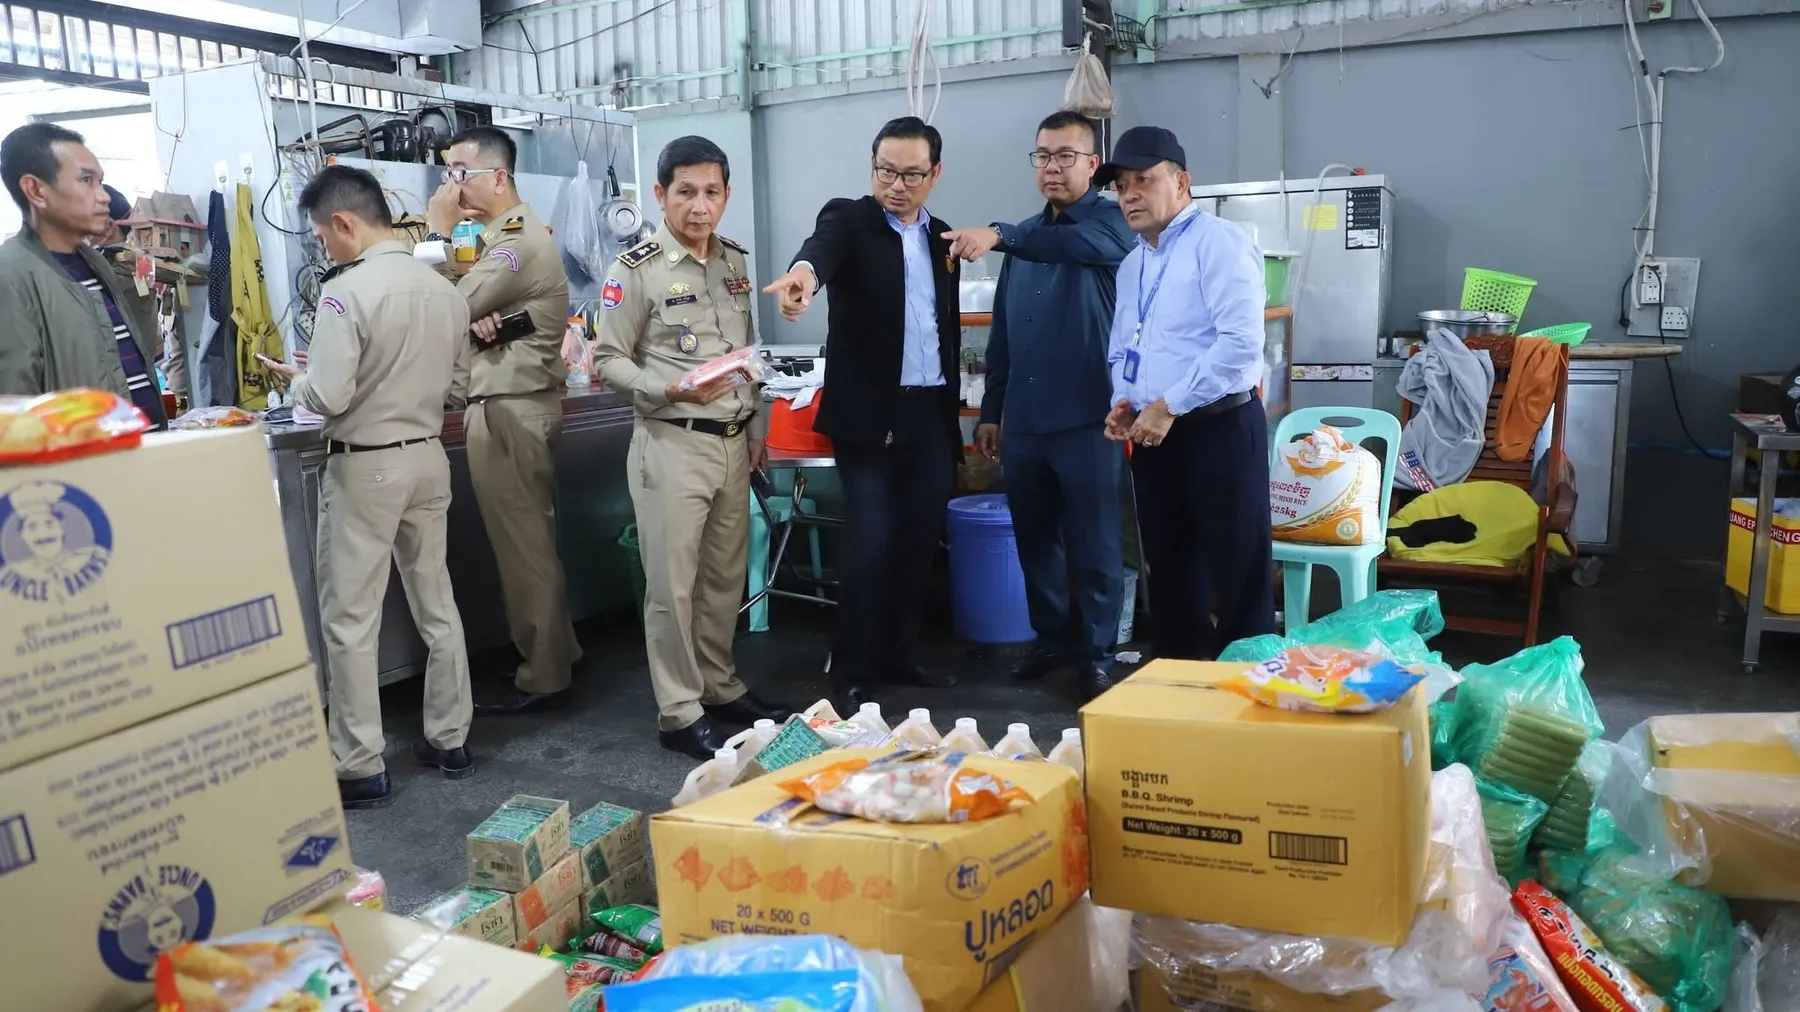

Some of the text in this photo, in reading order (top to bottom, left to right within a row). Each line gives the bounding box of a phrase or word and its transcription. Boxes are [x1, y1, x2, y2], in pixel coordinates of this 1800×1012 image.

[1294, 497, 1308, 506] RICE
[0, 568, 48, 602] UNCLE
[1122, 789, 1194, 807] B.B.Q. Shrimp
[1127, 819, 1239, 843] Net Weight: 20 x 500 g
[158, 863, 200, 895] UNCLE
[710, 919, 735, 934] NET
[736, 903, 811, 927] 20 x 500 G
[963, 878, 1055, 963] ปูหลอด
